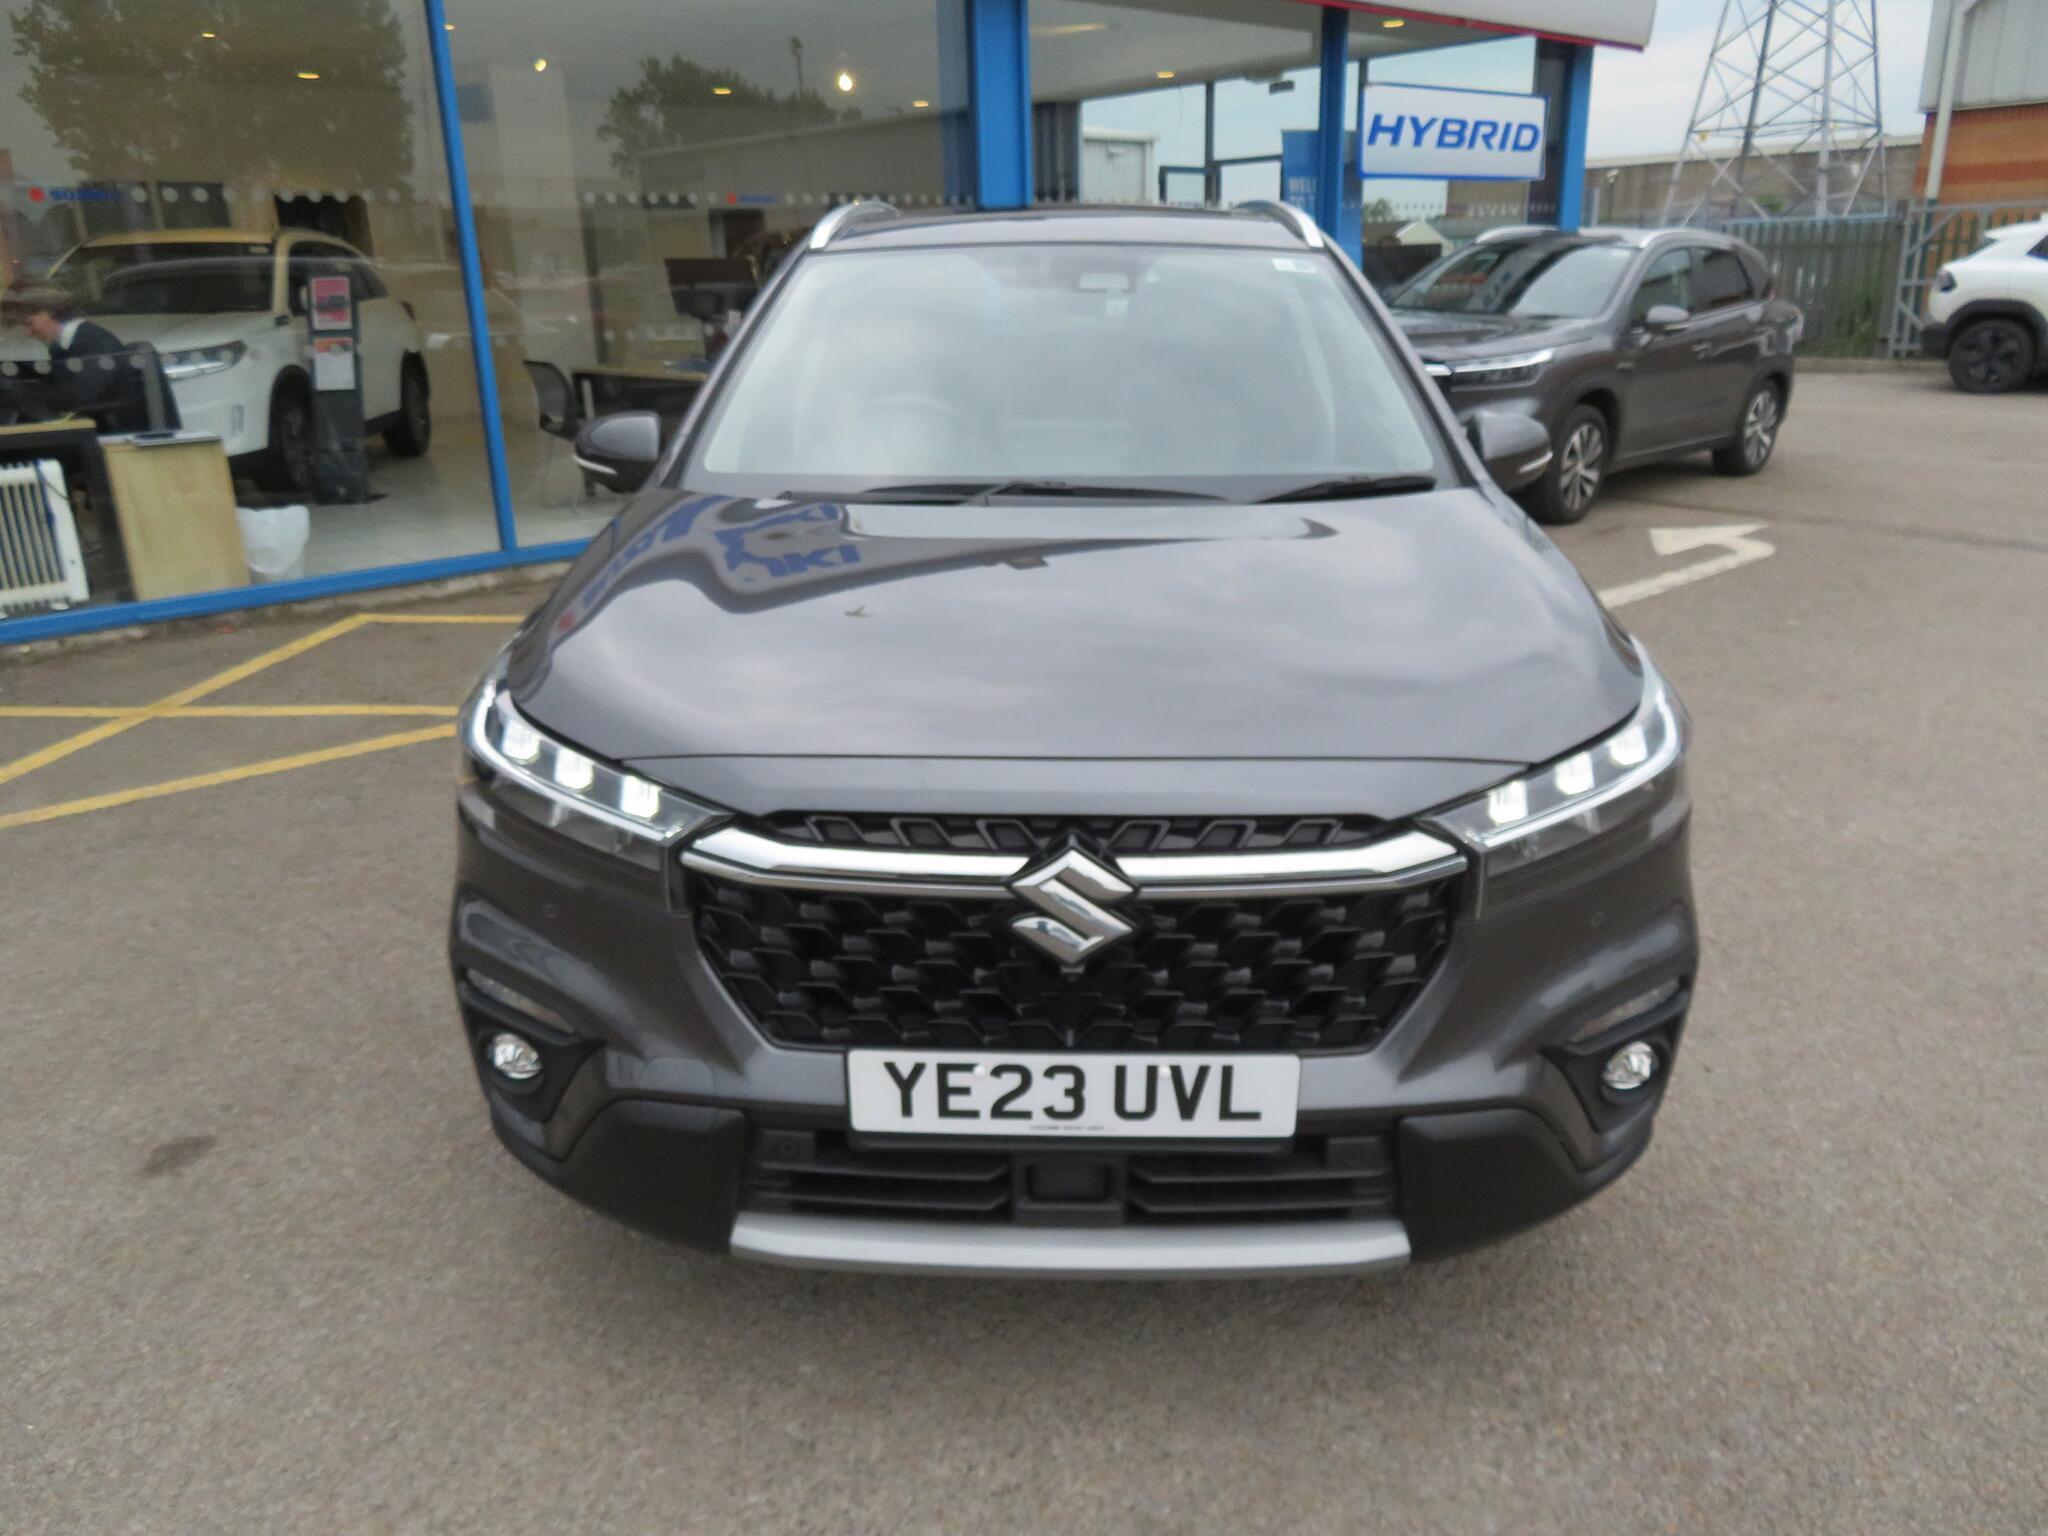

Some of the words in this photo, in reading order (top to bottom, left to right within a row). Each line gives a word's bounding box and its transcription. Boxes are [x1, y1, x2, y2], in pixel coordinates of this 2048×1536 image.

[1367, 114, 1541, 153] HYBRID
[883, 1061, 1086, 1121] YE23
[1113, 1064, 1262, 1122] UVL
